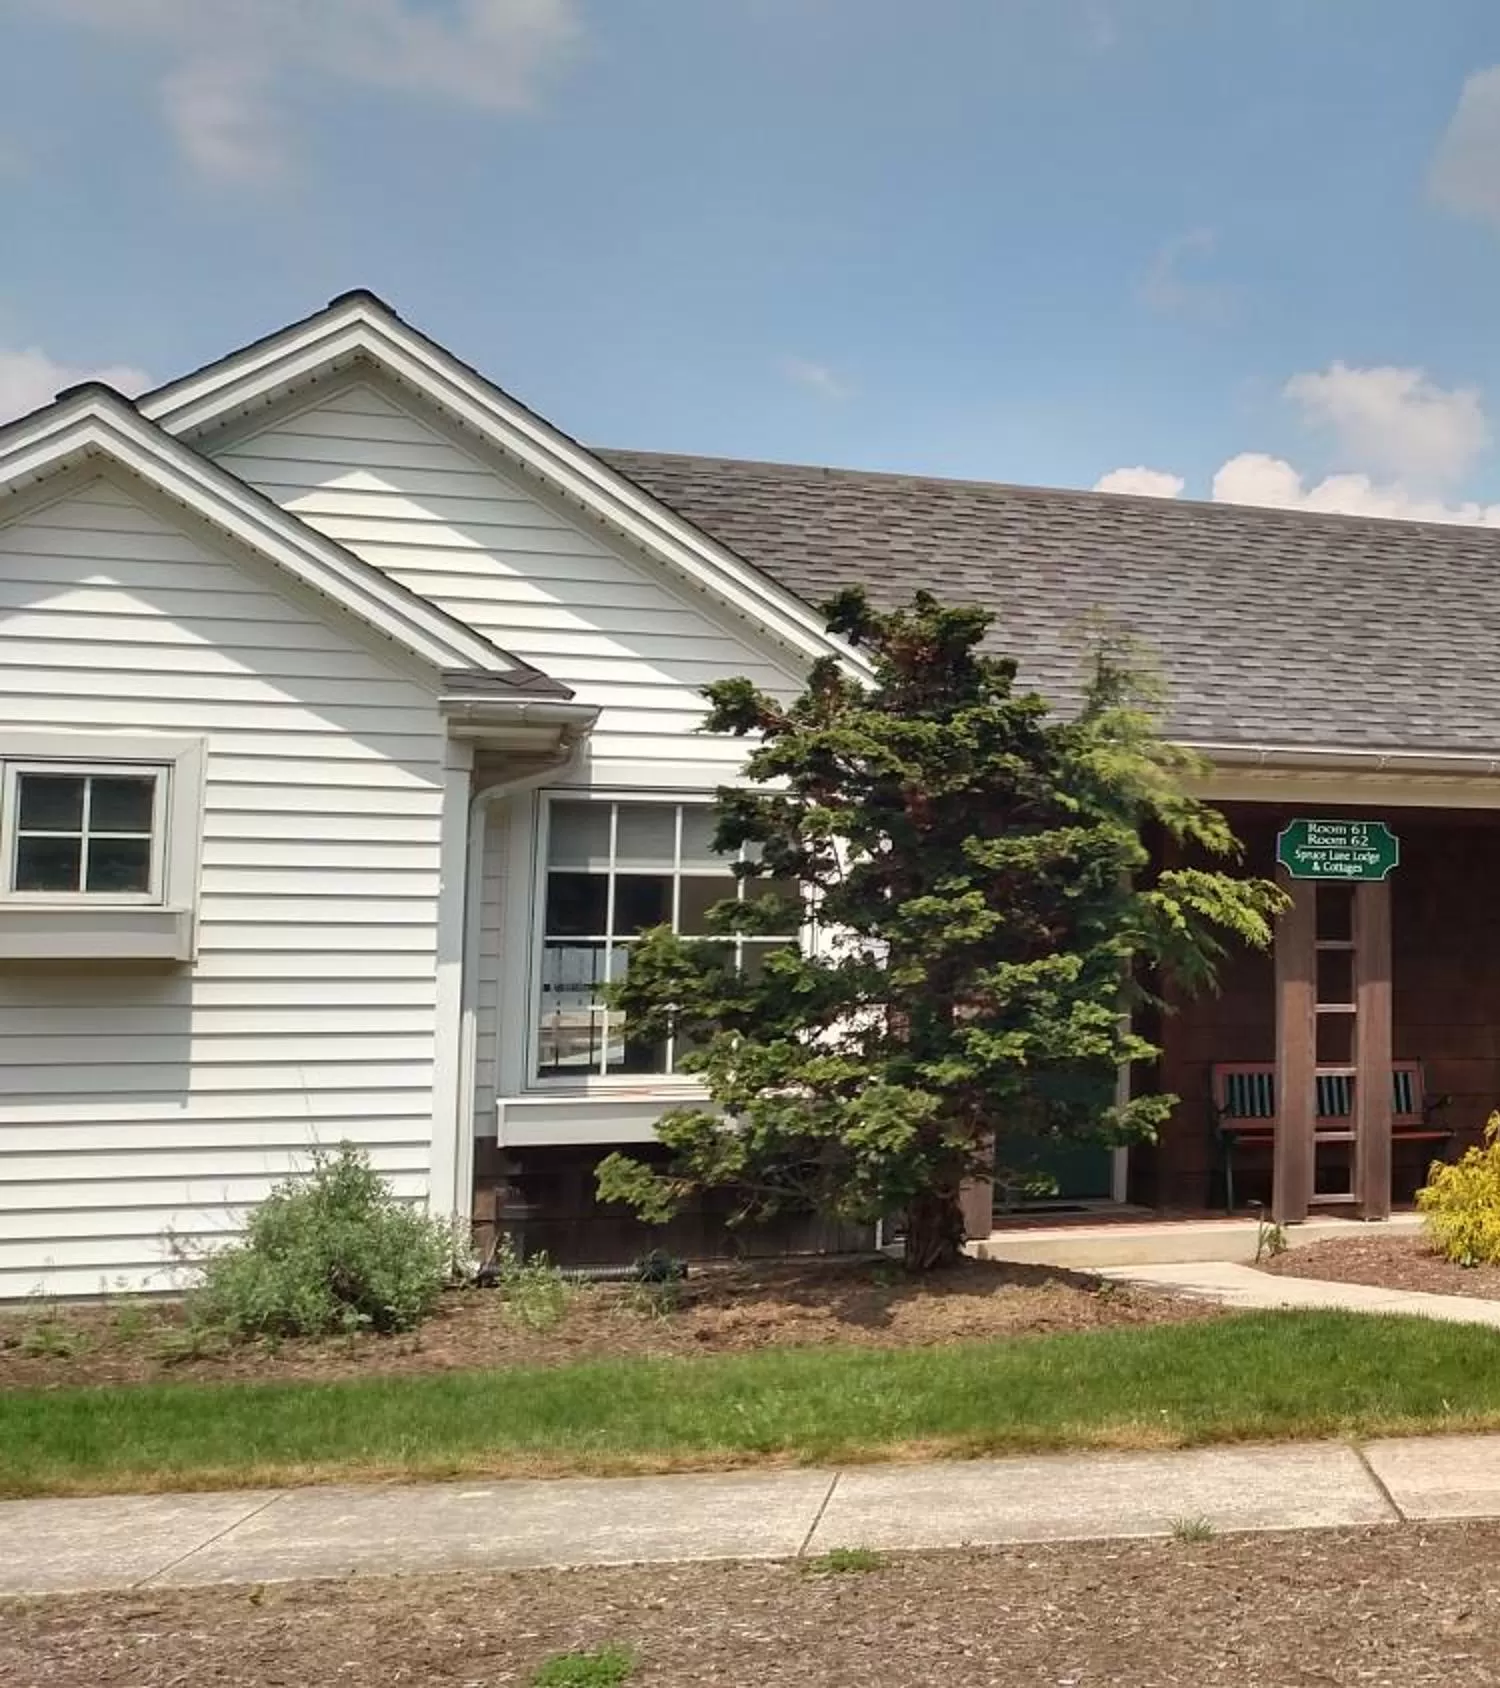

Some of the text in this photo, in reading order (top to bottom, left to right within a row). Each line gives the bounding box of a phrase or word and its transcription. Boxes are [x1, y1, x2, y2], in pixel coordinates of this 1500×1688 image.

[1308, 823, 1367, 835] Room 61
[1307, 834, 1369, 847] Room 62
[1294, 849, 1381, 865] Spruce Lane Lodge
[1312, 861, 1363, 875] & Cottages
